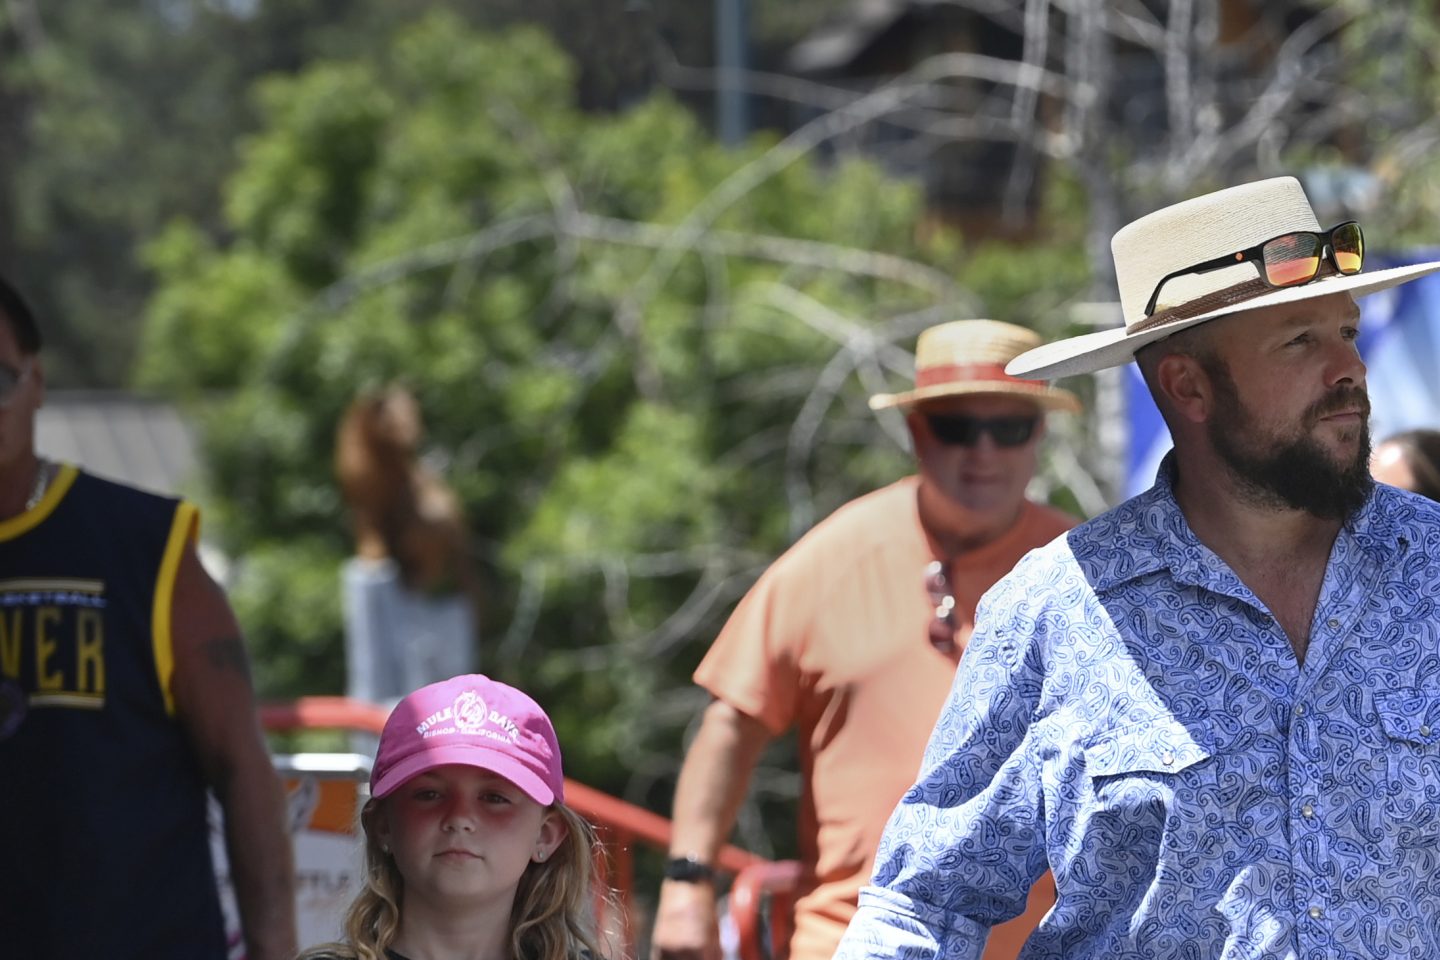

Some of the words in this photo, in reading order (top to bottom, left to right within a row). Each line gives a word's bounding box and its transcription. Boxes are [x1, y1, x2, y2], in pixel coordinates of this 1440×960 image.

[416, 707, 453, 735] MULE
[488, 710, 519, 739] DAYS
[423, 727, 456, 739] BISHOP
[461, 727, 512, 744] CALIFORNIA
